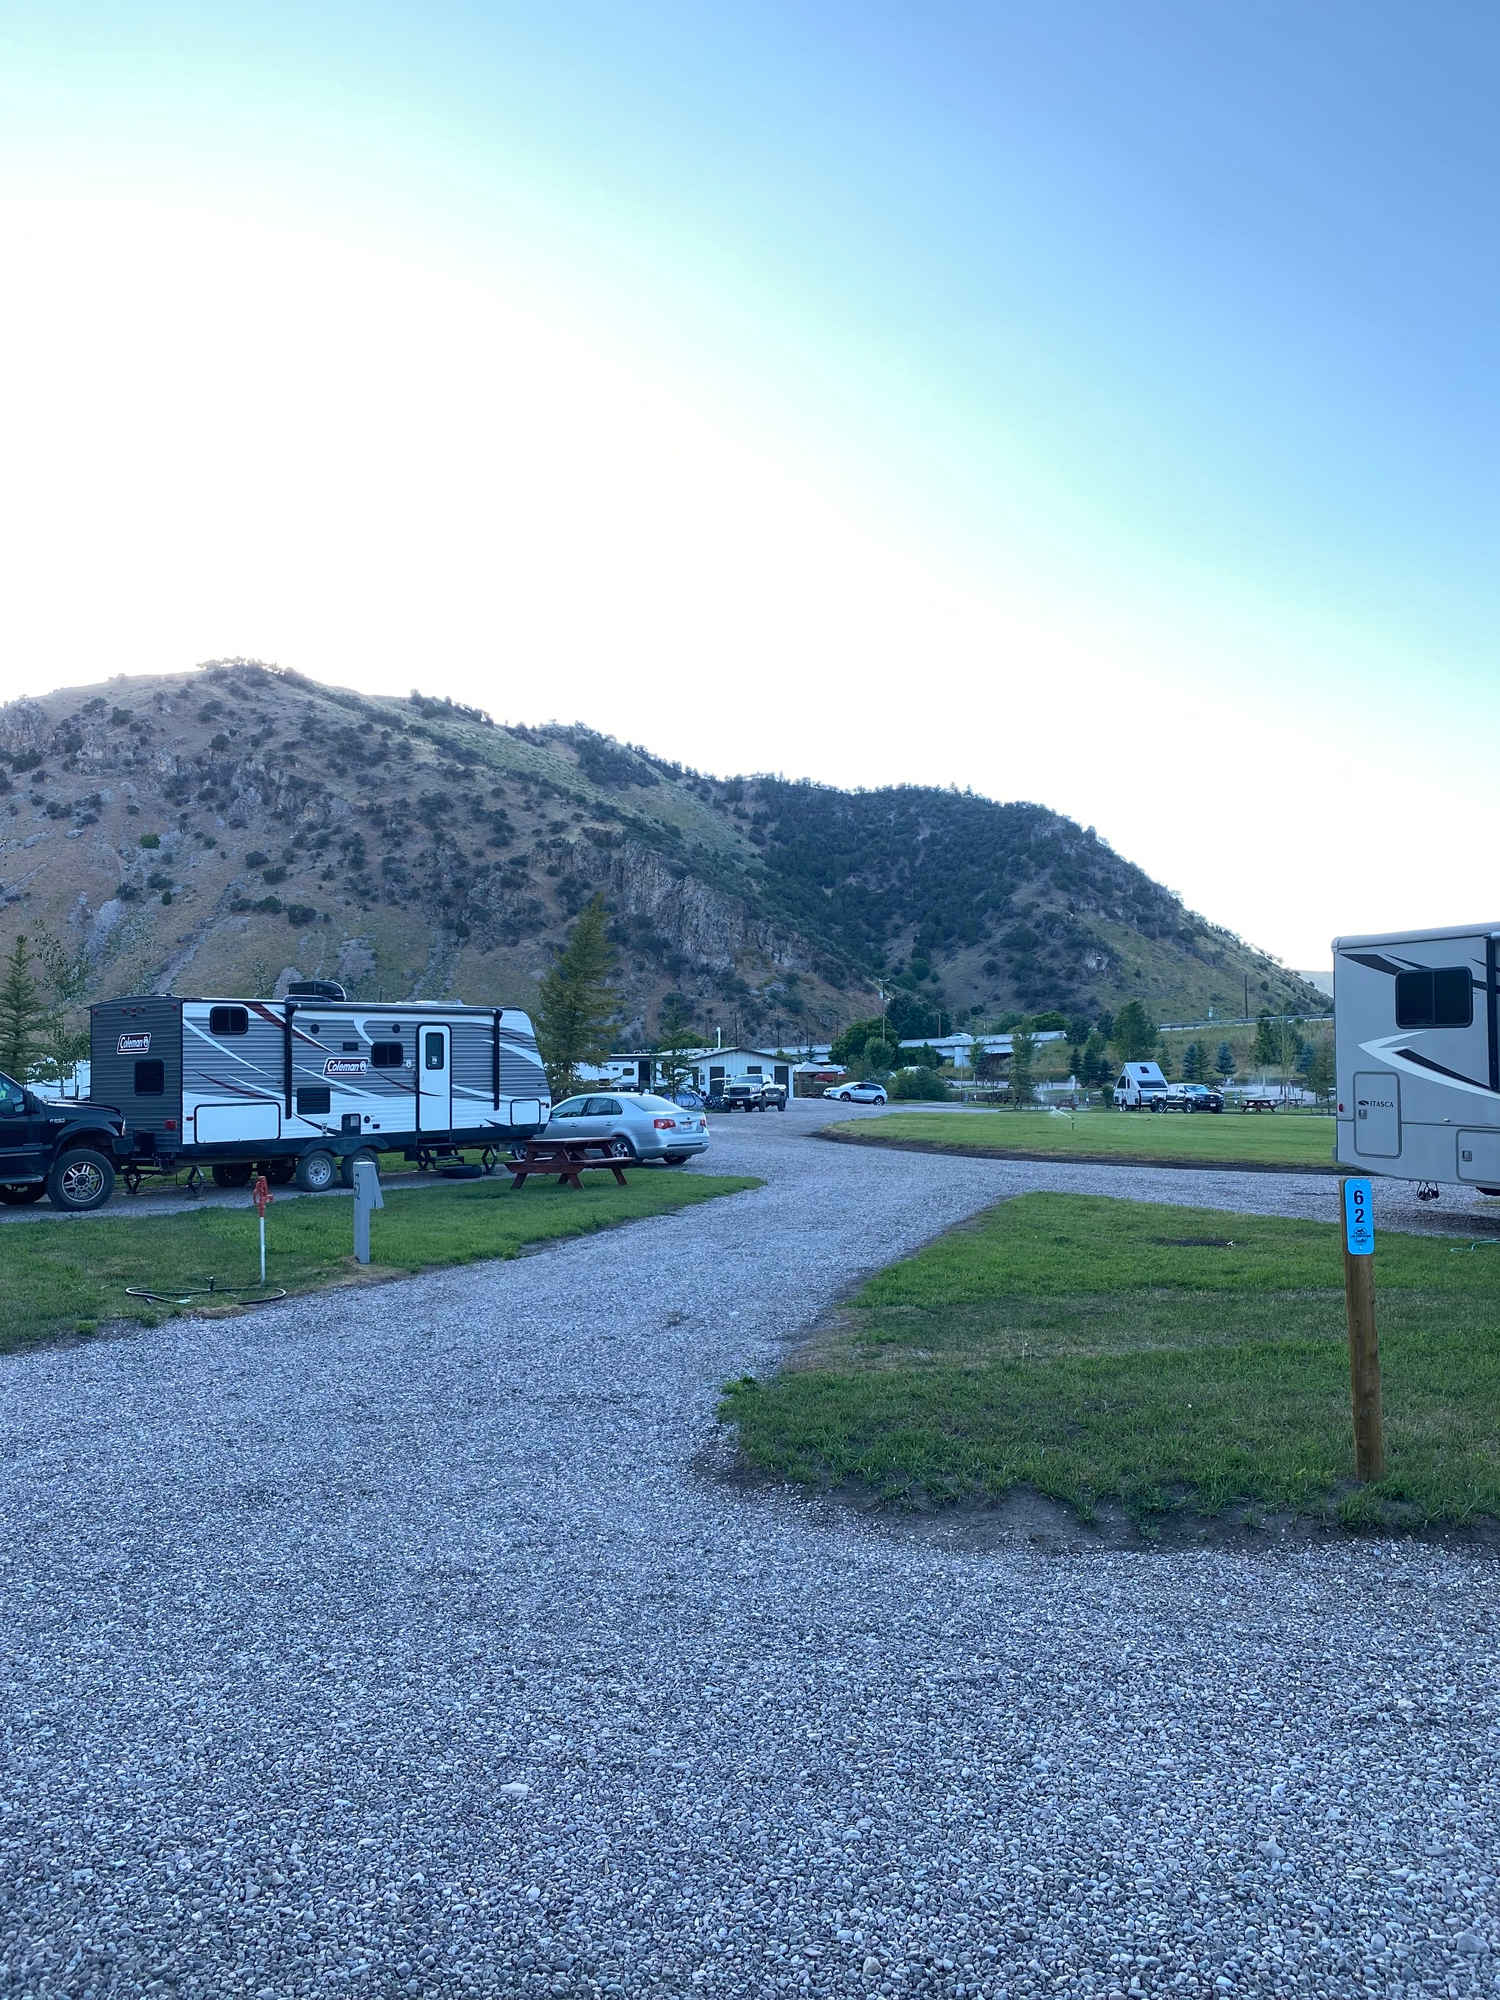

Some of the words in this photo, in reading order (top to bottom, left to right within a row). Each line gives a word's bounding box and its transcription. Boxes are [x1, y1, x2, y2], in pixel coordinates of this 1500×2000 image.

[120, 1037, 143, 1048] Coleman
[327, 1060, 359, 1072] Coleman
[1369, 1100, 1394, 1108] ITASCA
